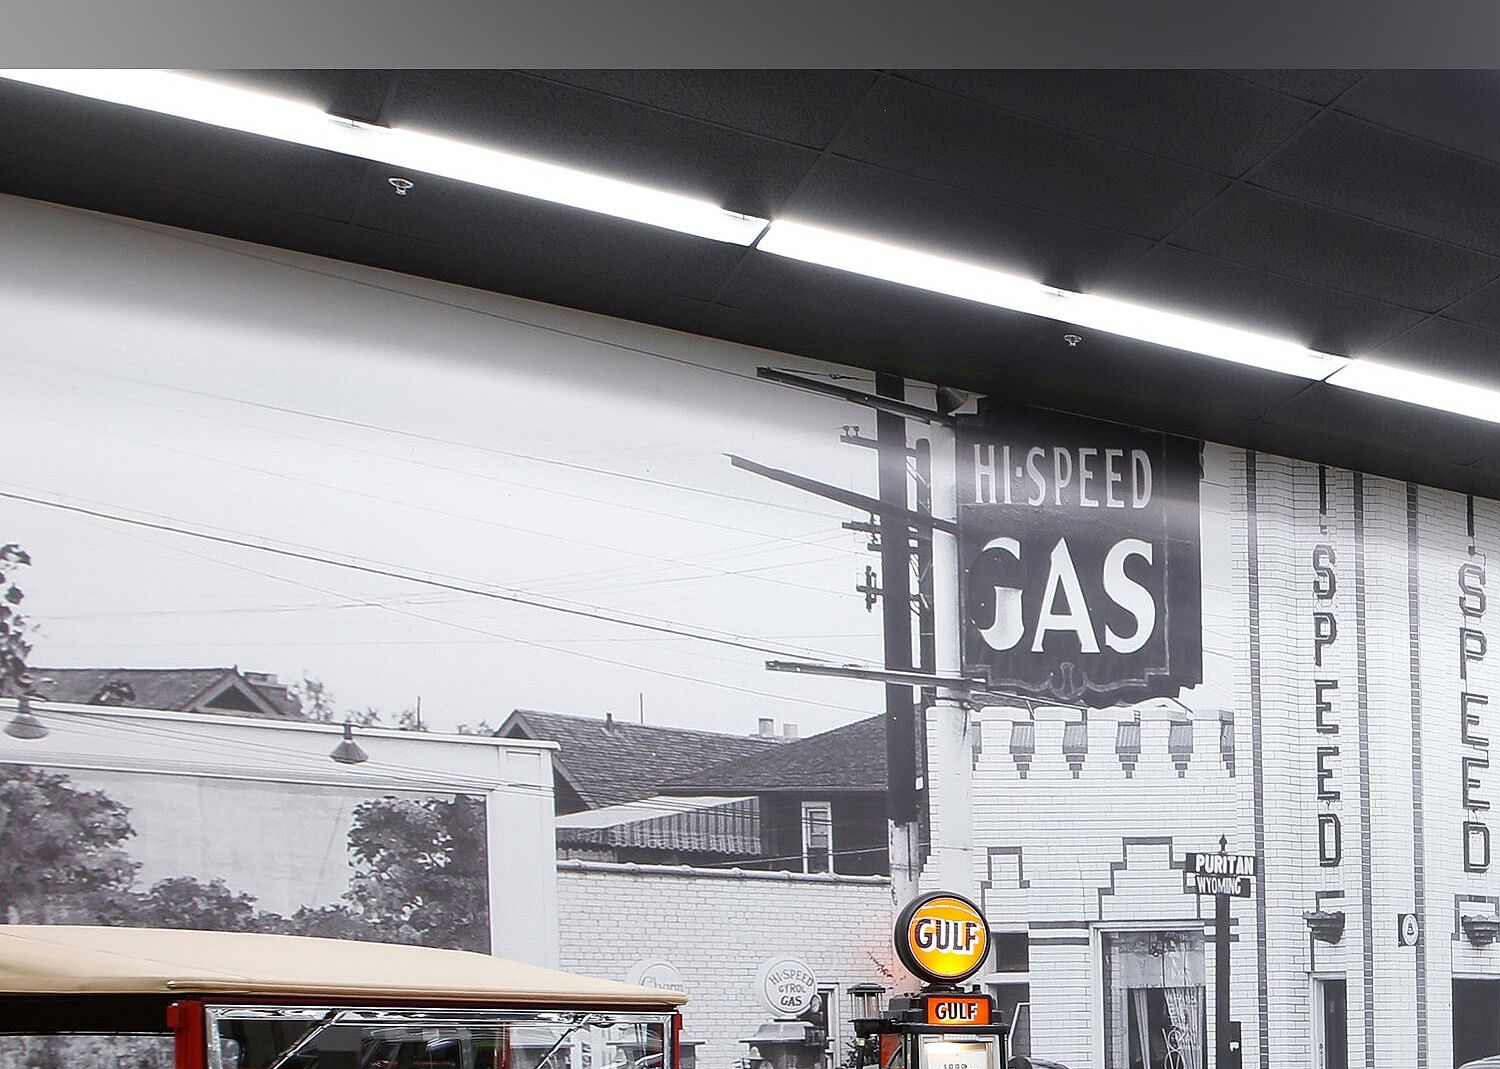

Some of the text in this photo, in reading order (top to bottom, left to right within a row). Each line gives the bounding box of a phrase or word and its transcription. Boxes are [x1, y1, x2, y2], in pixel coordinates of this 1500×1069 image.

[979, 537, 1156, 653] GAS
[1195, 853, 1254, 875] PURITAN
[1196, 876, 1241, 894] WYOMING
[914, 918, 979, 954] GULF
[780, 995, 803, 1007] GAS
[935, 1002, 979, 1020] GULF
